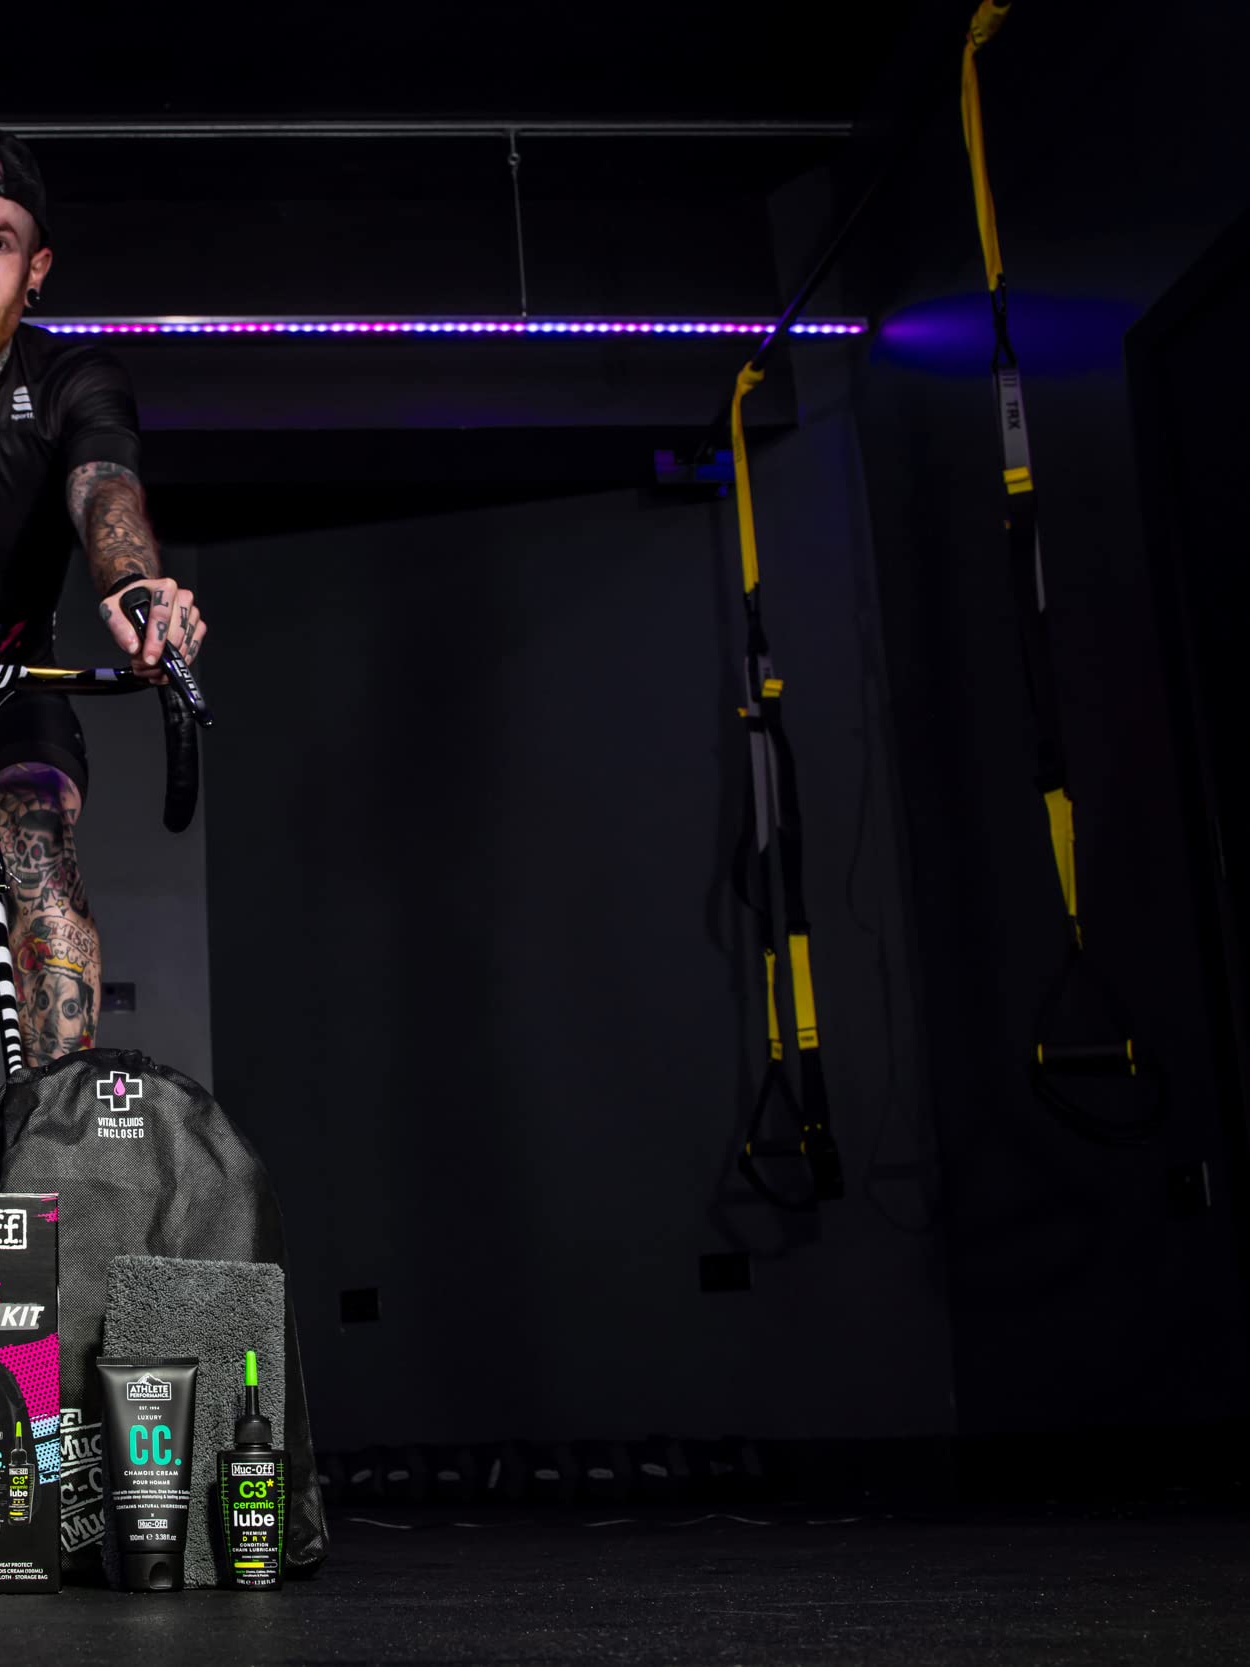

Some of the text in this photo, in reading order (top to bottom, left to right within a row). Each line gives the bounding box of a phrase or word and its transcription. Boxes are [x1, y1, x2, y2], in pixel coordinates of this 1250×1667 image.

[1006, 400, 1021, 430] TRX
[98, 1117, 144, 1127] VITAL FLUIDS
[98, 1128, 144, 1138] ENCLOSED
[1, 1306, 44, 1326] KIT
[129, 1424, 182, 1466] CC.
[234, 1465, 272, 1474] Muc-Off
[233, 1500, 274, 1509] ceramic
[234, 1510, 274, 1527] lube
